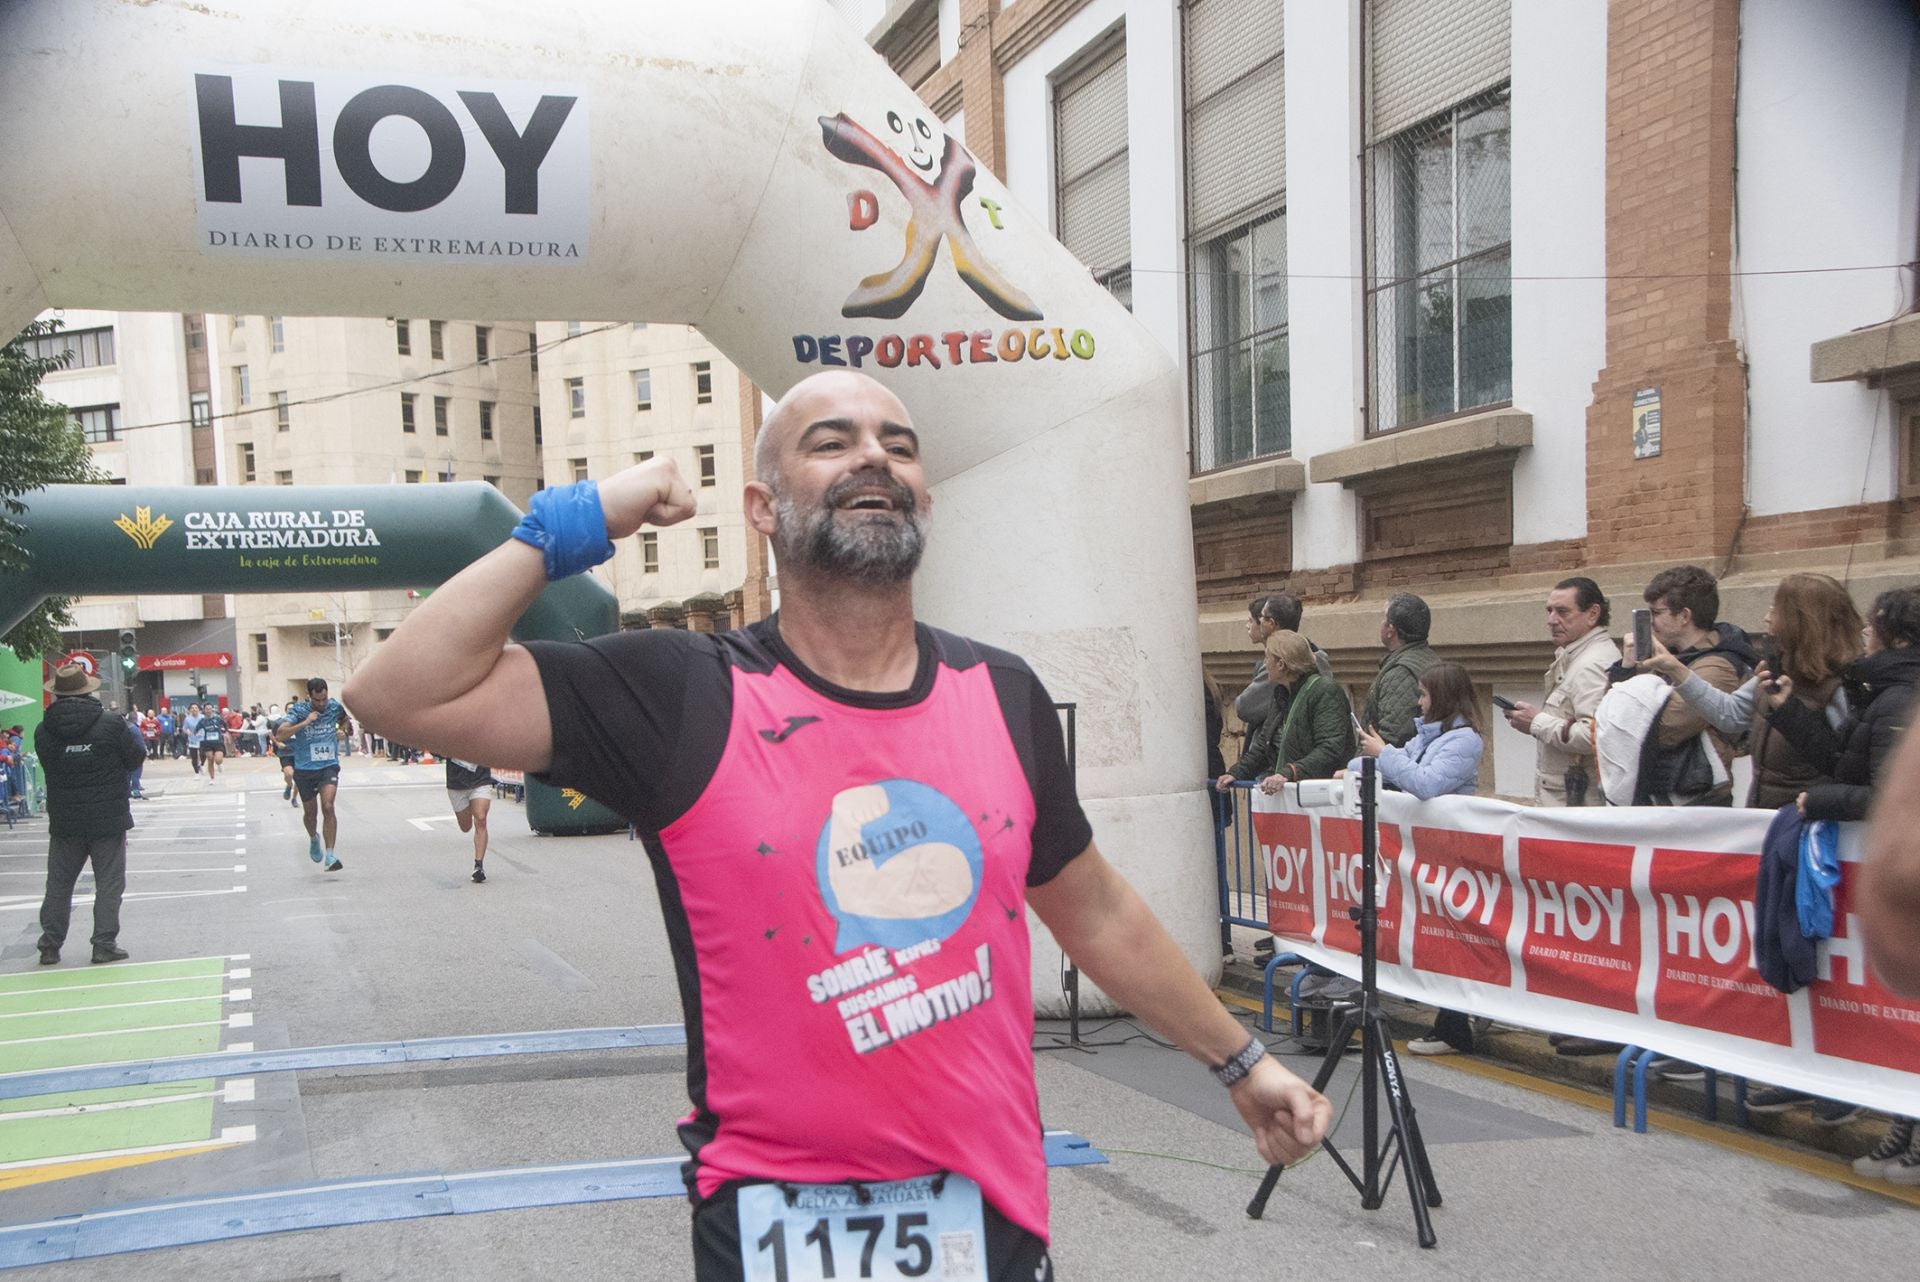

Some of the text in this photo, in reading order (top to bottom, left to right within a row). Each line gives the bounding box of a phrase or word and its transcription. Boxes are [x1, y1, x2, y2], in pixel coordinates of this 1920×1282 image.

[194, 73, 578, 215] HOY
[208, 230, 579, 258] DIARIO DE EXTREMADURA
[792, 328, 1096, 370] DEPORTEOCIO
[184, 509, 366, 531] CAJA RURAL DE
[185, 528, 381, 550] EXTREMADURA
[256, 556, 280, 569] caja
[284, 555, 298, 568] de
[302, 554, 378, 566] Extremadura
[160, 658, 186, 667] Santander
[836, 820, 928, 868] EQUIPO
[1416, 863, 1624, 946] HOY HOY
[1421, 925, 1446, 939] DIARIO
[1446, 930, 1455, 939] DE
[806, 946, 895, 1004] SONRÍE
[1529, 945, 1633, 972] DIARIO DE EXTREMADURA
[1666, 968, 1696, 984] DIARIO
[1698, 974, 1709, 985] DE
[837, 973, 919, 1020] BUSCAMOS
[1819, 995, 1859, 1013] DIARIO
[1862, 1002, 1879, 1017] DE
[845, 1012, 891, 1054] EL
[1384, 1050, 1402, 1098] VONYX
[758, 1211, 932, 1282] 1175
